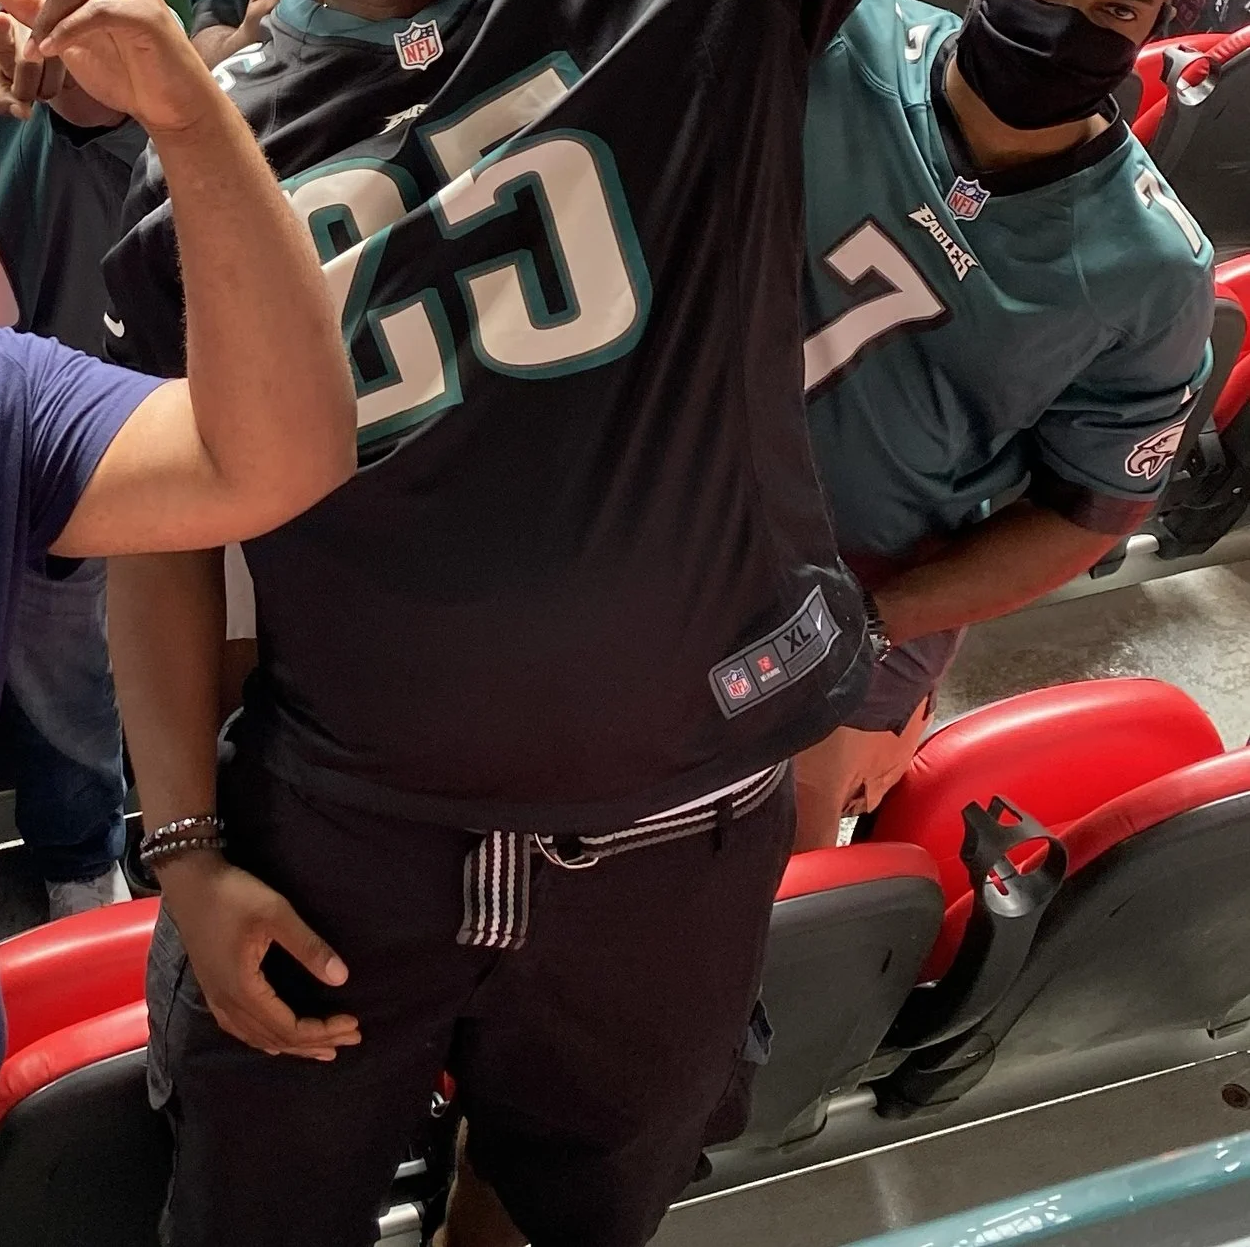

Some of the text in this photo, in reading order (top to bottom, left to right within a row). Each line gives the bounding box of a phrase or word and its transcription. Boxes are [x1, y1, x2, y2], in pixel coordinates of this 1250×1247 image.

[403, 38, 437, 65] NFL
[907, 203, 980, 282] EAGLES
[783, 625, 812, 654] XL
